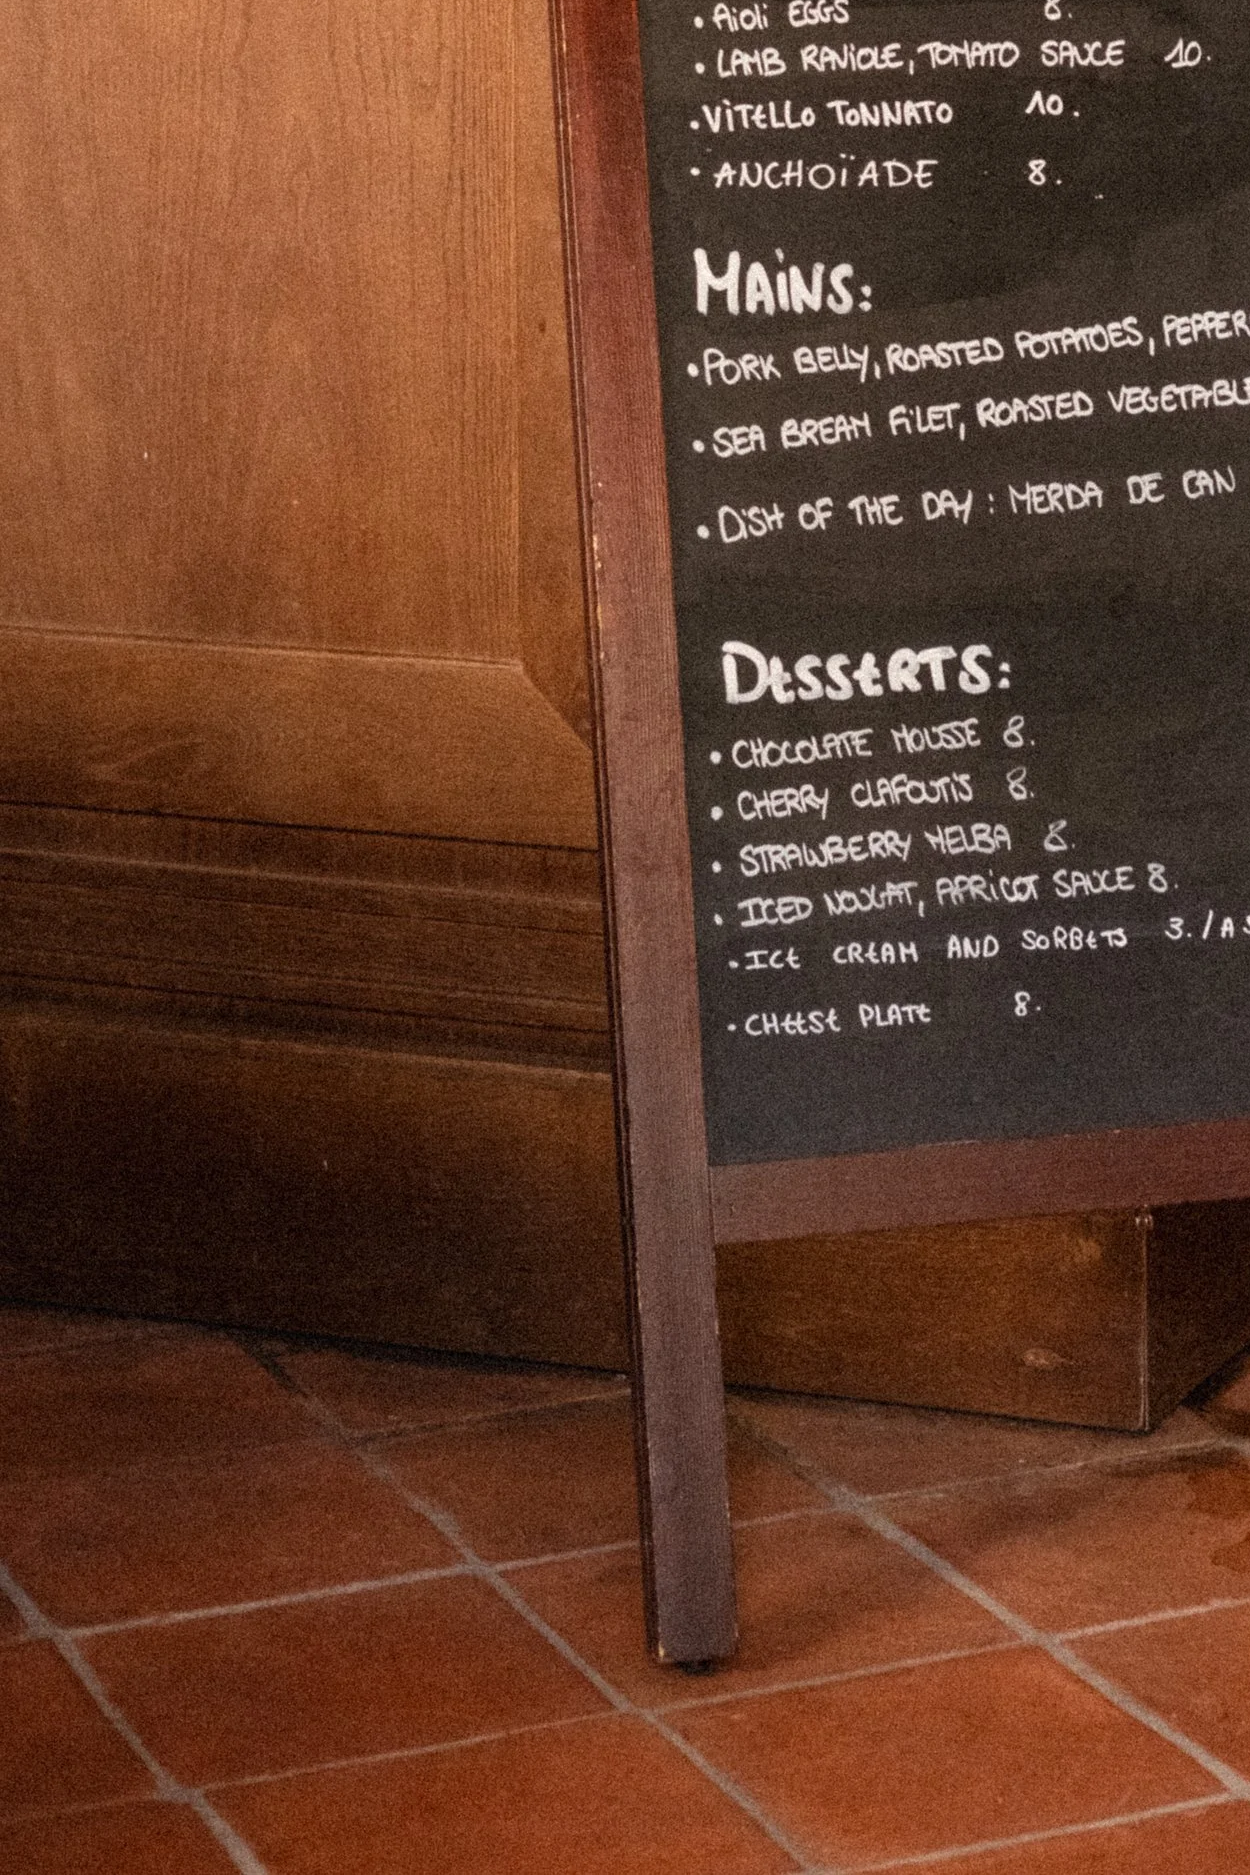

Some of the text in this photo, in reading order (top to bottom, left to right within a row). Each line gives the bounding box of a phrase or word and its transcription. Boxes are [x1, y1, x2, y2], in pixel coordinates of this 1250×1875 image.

[716, 45, 787, 79] LAMB
[916, 40, 1021, 69] TOMATO
[1040, 39, 1126, 68] SAUCE
[702, 346, 782, 386] PORK
[884, 336, 1005, 375] ROASTED
[712, 424, 767, 459] SEA
[780, 411, 873, 450] BREAM
[975, 390, 1094, 428] ROASTED
[797, 496, 834, 531] OF
[847, 494, 904, 526] THE
[921, 488, 974, 525] DAY
[1008, 480, 1104, 514] MERDA
[1126, 472, 1166, 505] DE
[1182, 466, 1237, 500] CAN
[720, 640, 1012, 705] DESSERTS:
[731, 728, 874, 769] CHOCOLATE
[890, 717, 982, 754] MOUSSE
[736, 782, 829, 821] CHERRY
[739, 829, 912, 877] STRAWBERRY
[924, 822, 1012, 856] MELBA
[737, 895, 814, 928] ICED
[1052, 865, 1136, 899] SAUCE
[744, 947, 801, 971] ICE
[832, 941, 920, 966] CREAM
[946, 934, 1001, 960] AND
[1020, 925, 1129, 952] SORBETS
[744, 1008, 841, 1036] CHEESE
[858, 1003, 932, 1029] PLATE
